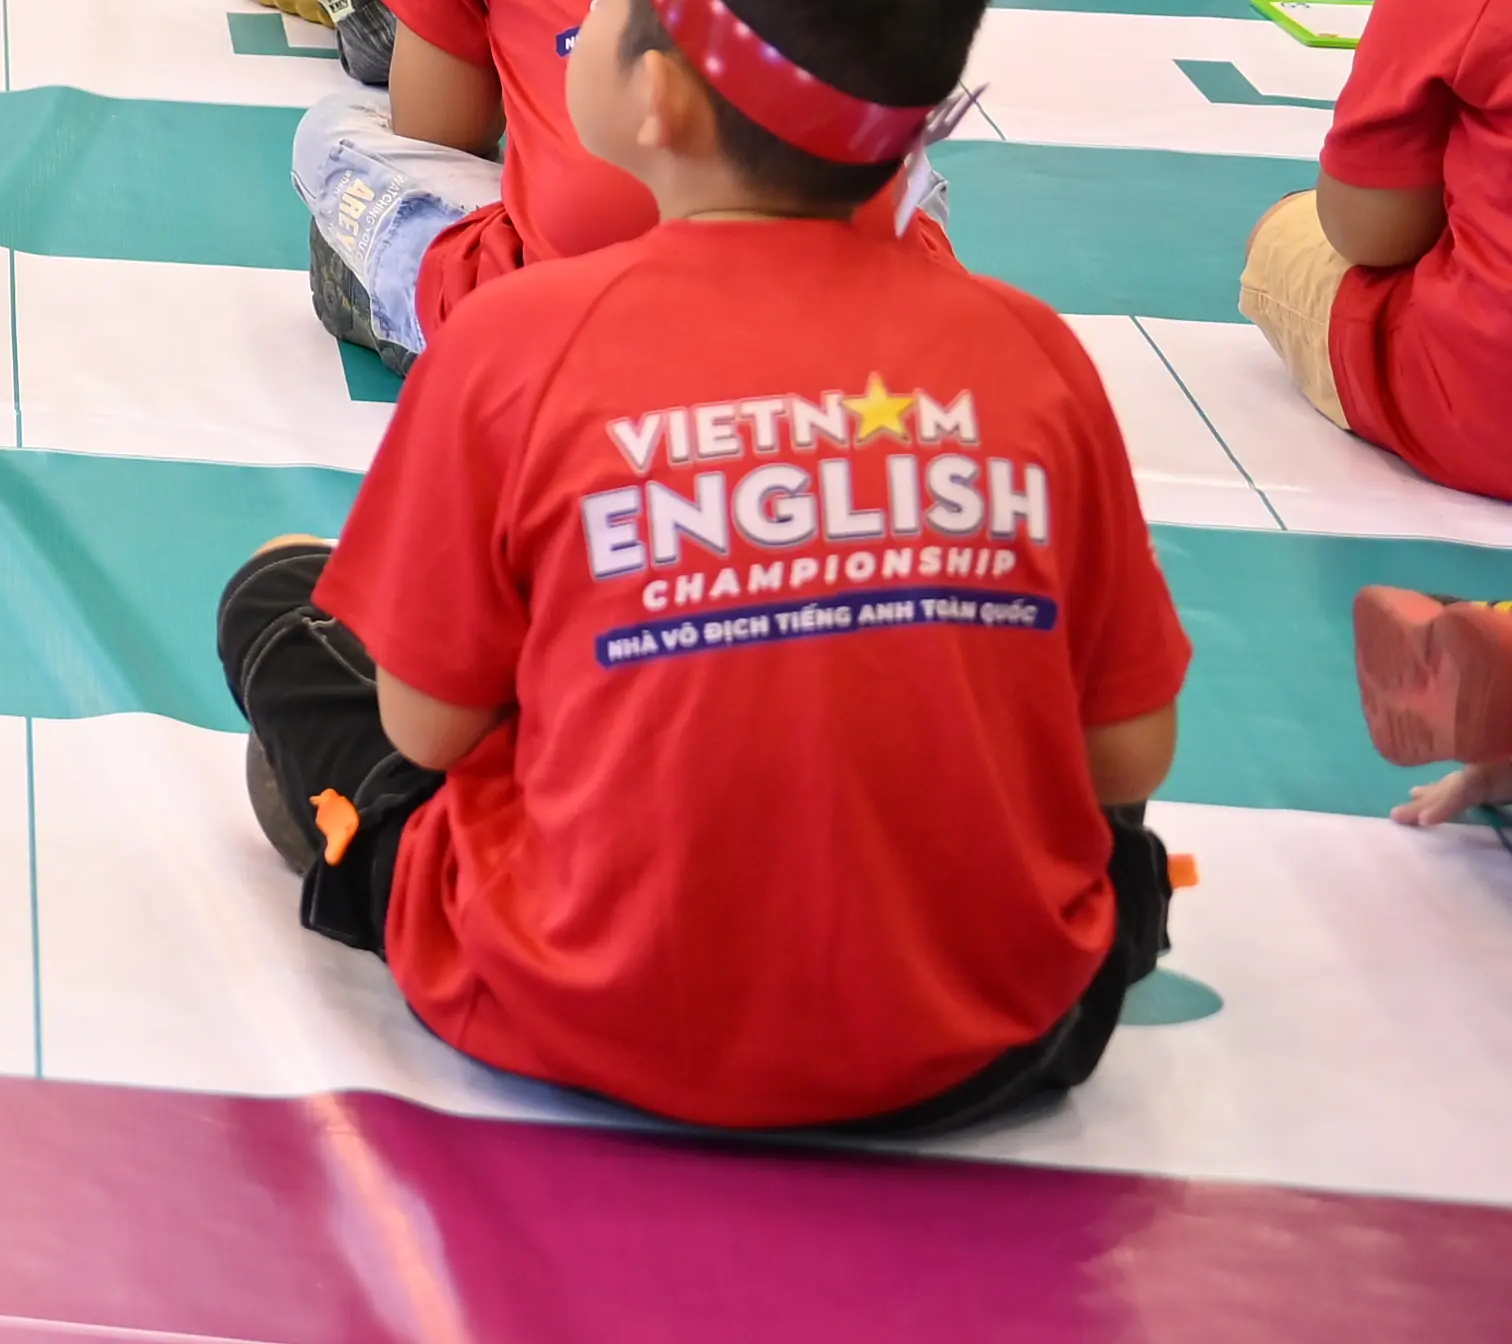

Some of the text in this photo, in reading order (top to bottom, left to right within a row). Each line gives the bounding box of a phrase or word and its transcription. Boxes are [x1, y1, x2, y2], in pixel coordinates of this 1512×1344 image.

[579, 453, 1050, 580] ENGLISH
[642, 546, 1016, 611] CHAMPIONSHIP
[608, 627, 659, 662] NHÀ
[664, 615, 698, 653] VÔ
[705, 612, 771, 652] ĐỊCH
[776, 600, 852, 641] TIẾNG
[859, 600, 913, 629] ANH
